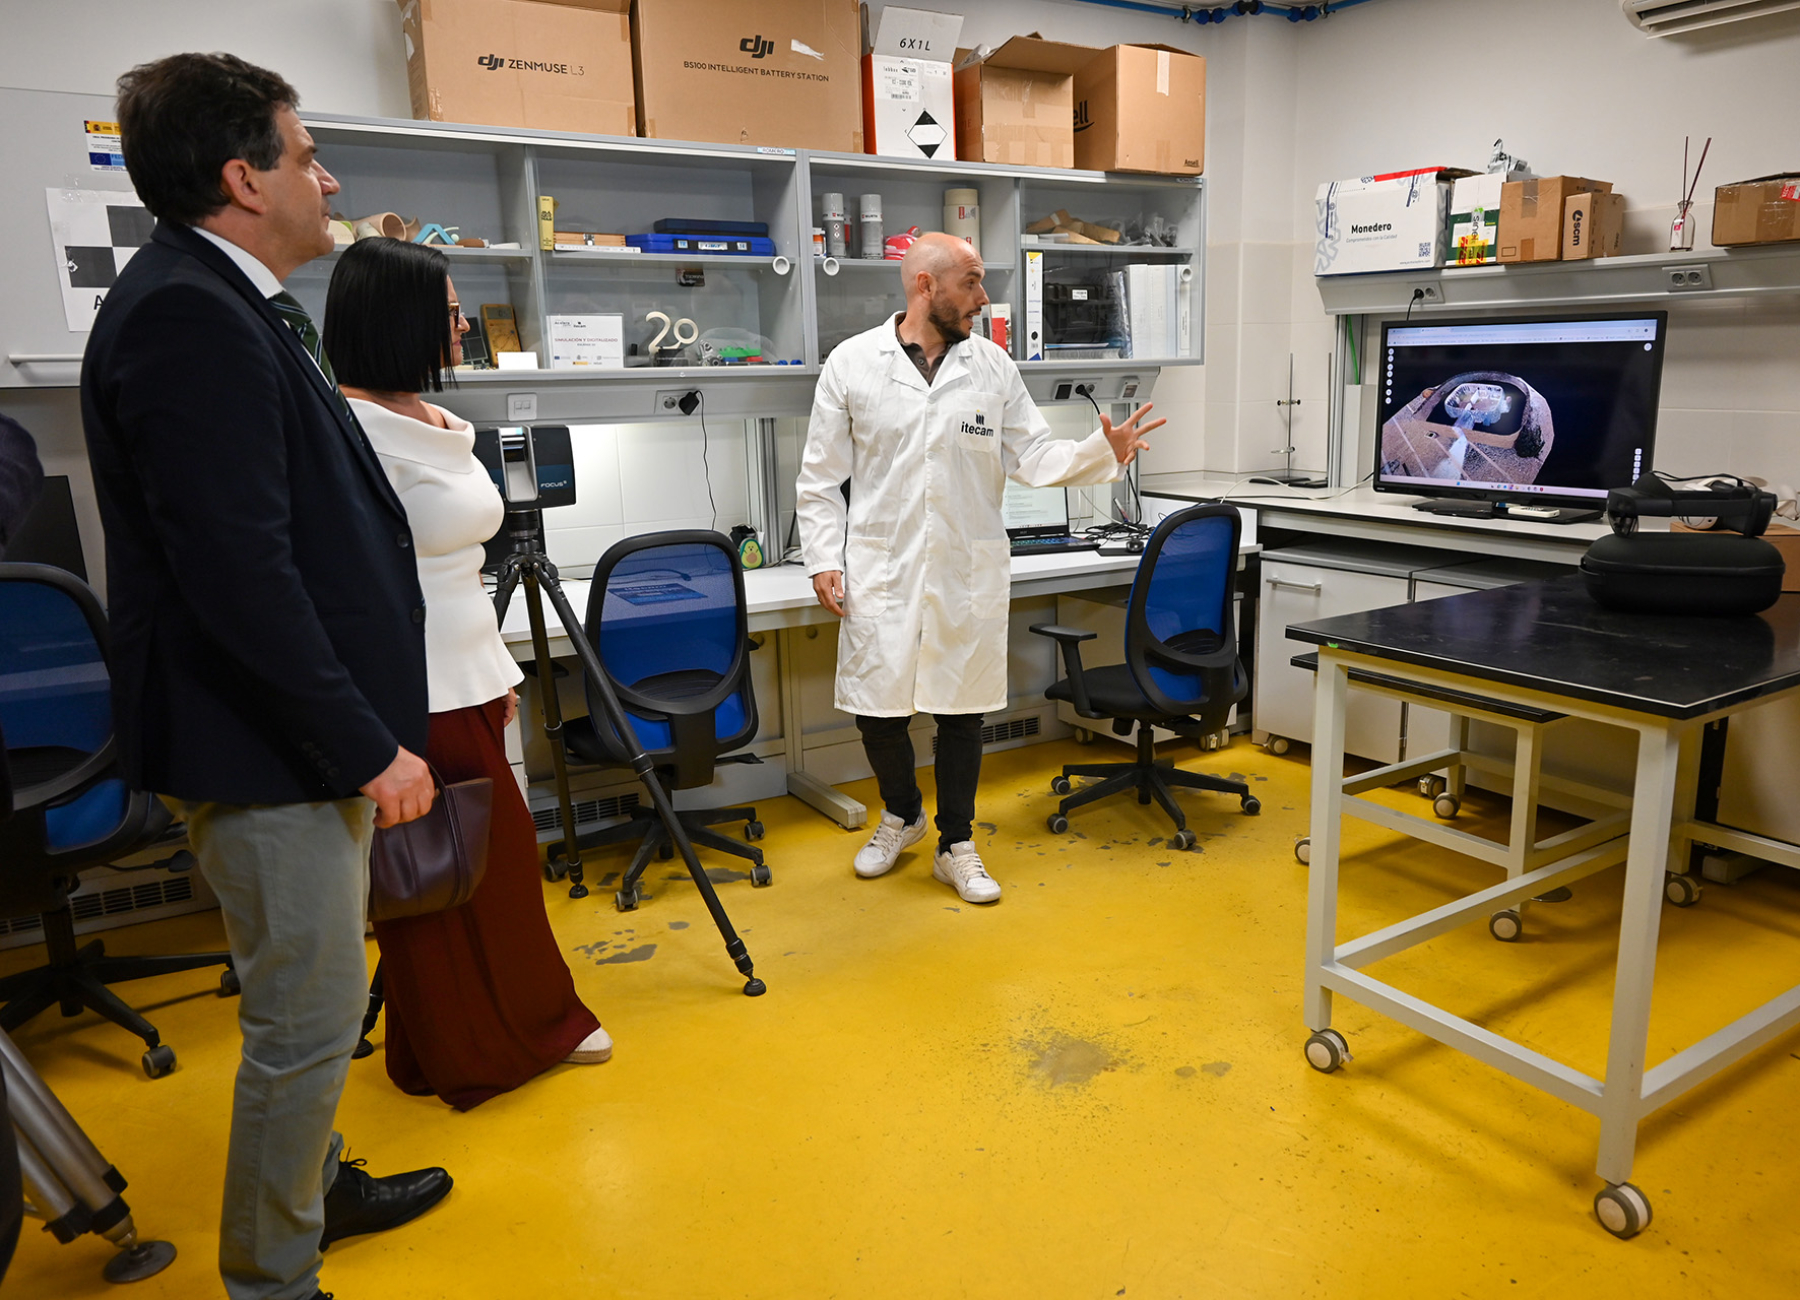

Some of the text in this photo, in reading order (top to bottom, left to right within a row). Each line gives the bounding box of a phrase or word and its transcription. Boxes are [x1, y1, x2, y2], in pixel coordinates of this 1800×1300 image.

[508, 58, 568, 74] ZENMUSE
[570, 65, 585, 76] L3
[683, 60, 830, 82] BS100 INTELLIGENT BATTERY STATION
[1351, 222, 1392, 234] Monedero
[1572, 222, 1581, 246] scm
[960, 420, 994, 437] itecam
